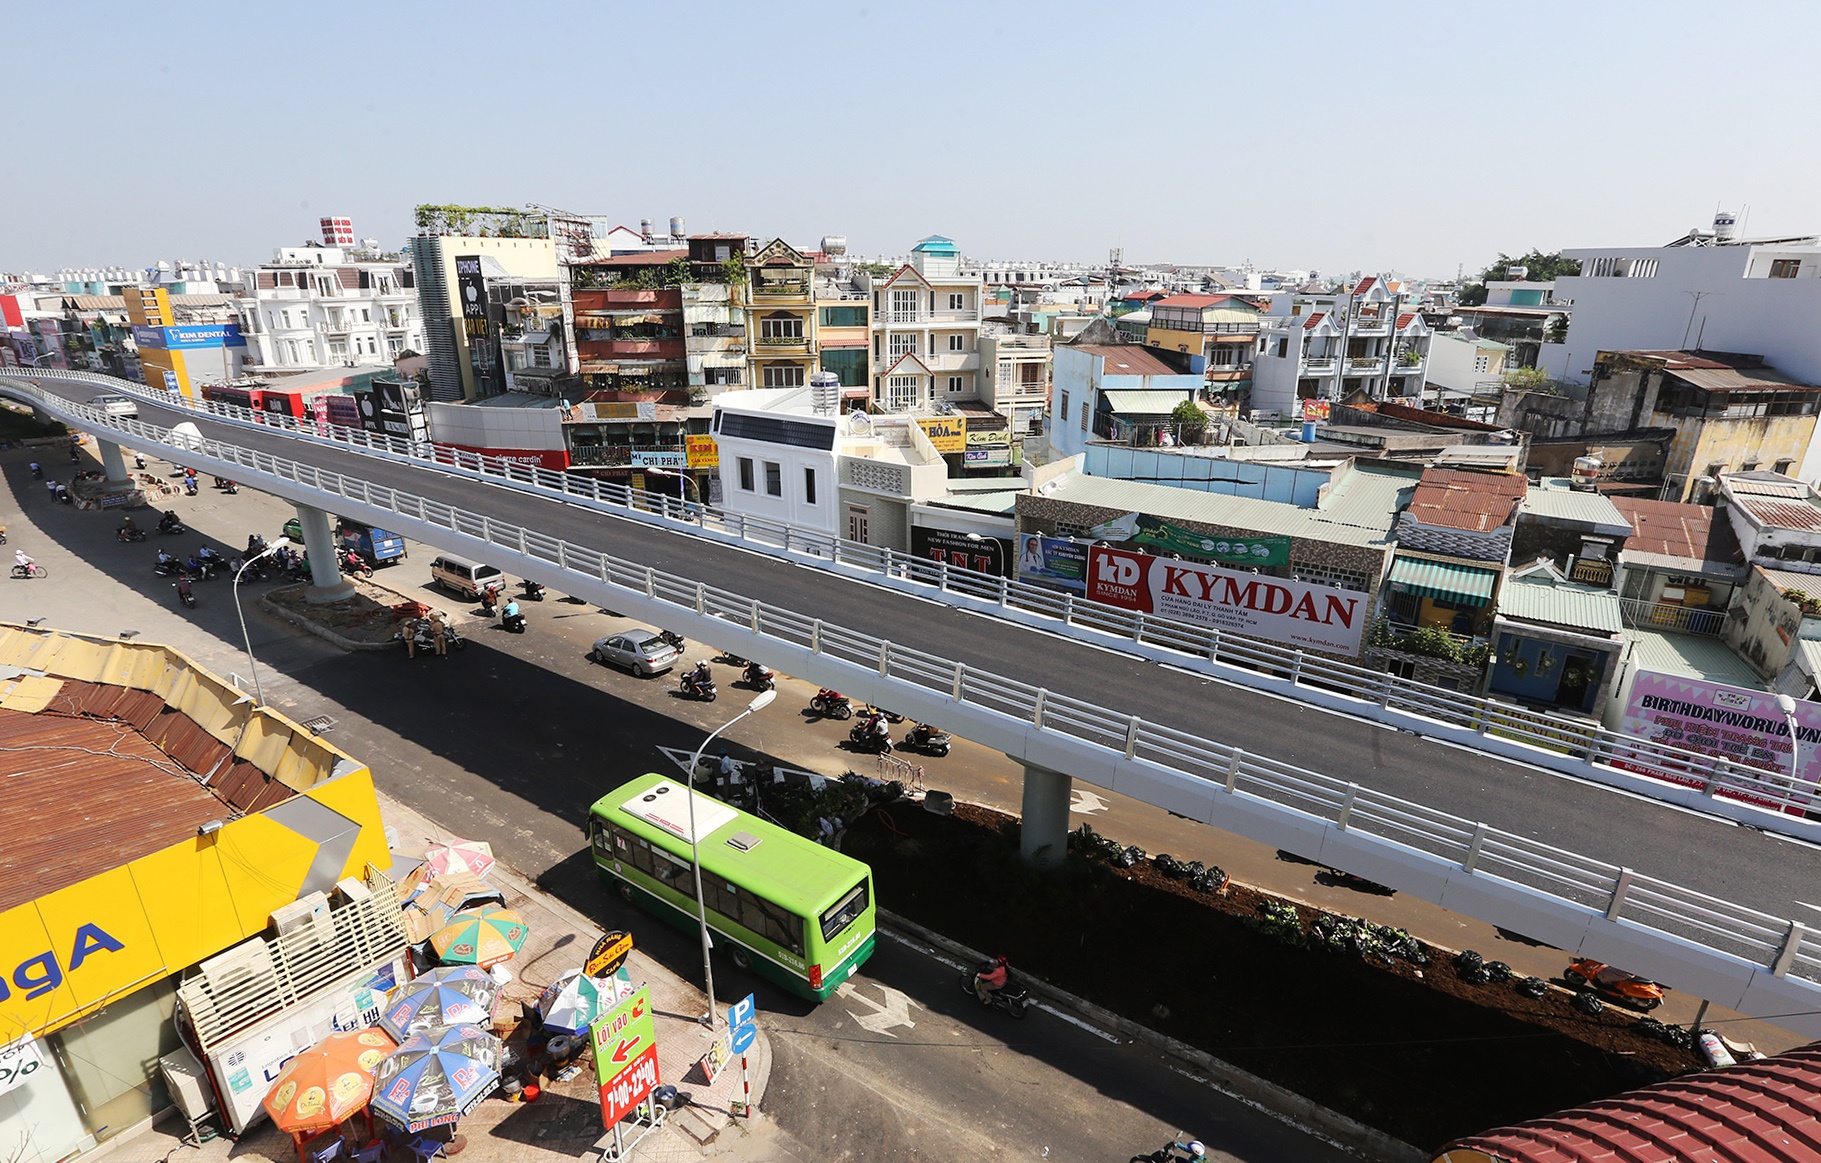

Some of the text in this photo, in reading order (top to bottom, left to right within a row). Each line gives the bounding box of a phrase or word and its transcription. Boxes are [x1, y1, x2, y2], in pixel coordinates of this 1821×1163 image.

[180, 330, 232, 339] KIM DENTAL
[518, 453, 541, 464] cardin
[942, 538, 967, 548] FASHION
[1096, 590, 1137, 602] SINCE 1954
[1097, 582, 1138, 597] KYMDAN
[1162, 565, 1359, 629] KYMDAN
[1175, 598, 1192, 606] HÀNG
[1235, 608, 1248, 617] TÂM
[1291, 634, 1350, 651] www.kymdan.com
[1684, 721, 1719, 738] KIỆN
[1721, 729, 1768, 748] TRANG
[1751, 746, 1777, 761] EM
[734, 998, 750, 1026] P
[410, 1113, 459, 1132] PHI LONG
